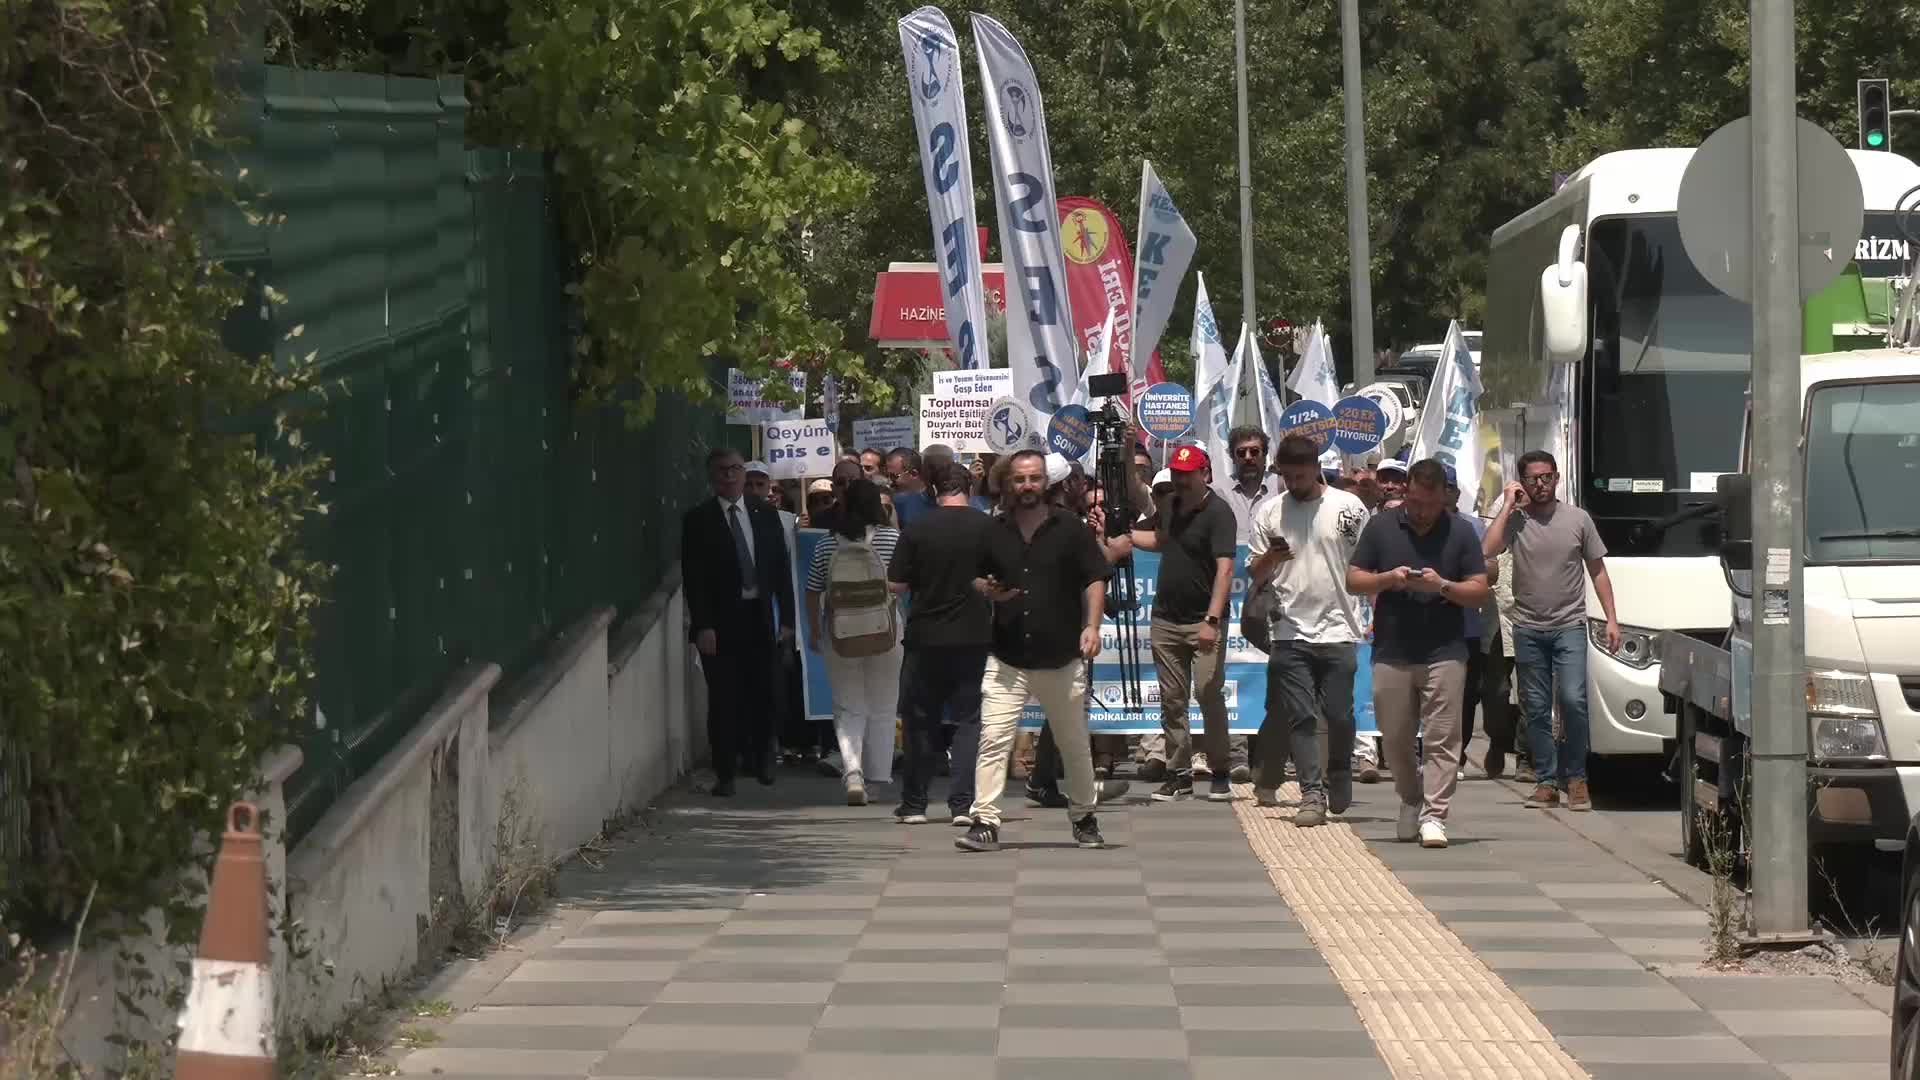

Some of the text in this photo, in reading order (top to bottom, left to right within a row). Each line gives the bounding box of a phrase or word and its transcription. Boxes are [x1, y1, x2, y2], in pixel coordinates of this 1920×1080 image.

[1855, 235, 1911, 260] RİZM
[974, 383, 993, 393] Eden
[1145, 393, 1190, 401] ÜNİVERSİTE
[928, 398, 993, 409] Toplumsal
[1145, 402, 1190, 410] HASTANESİ
[921, 409, 957, 420] Cinsiyet
[1289, 409, 1319, 425] 7/24
[931, 431, 984, 439] İSTİYORUZ
[816, 446, 831, 456] e
[1089, 710, 1143, 721] NDİKALARI
